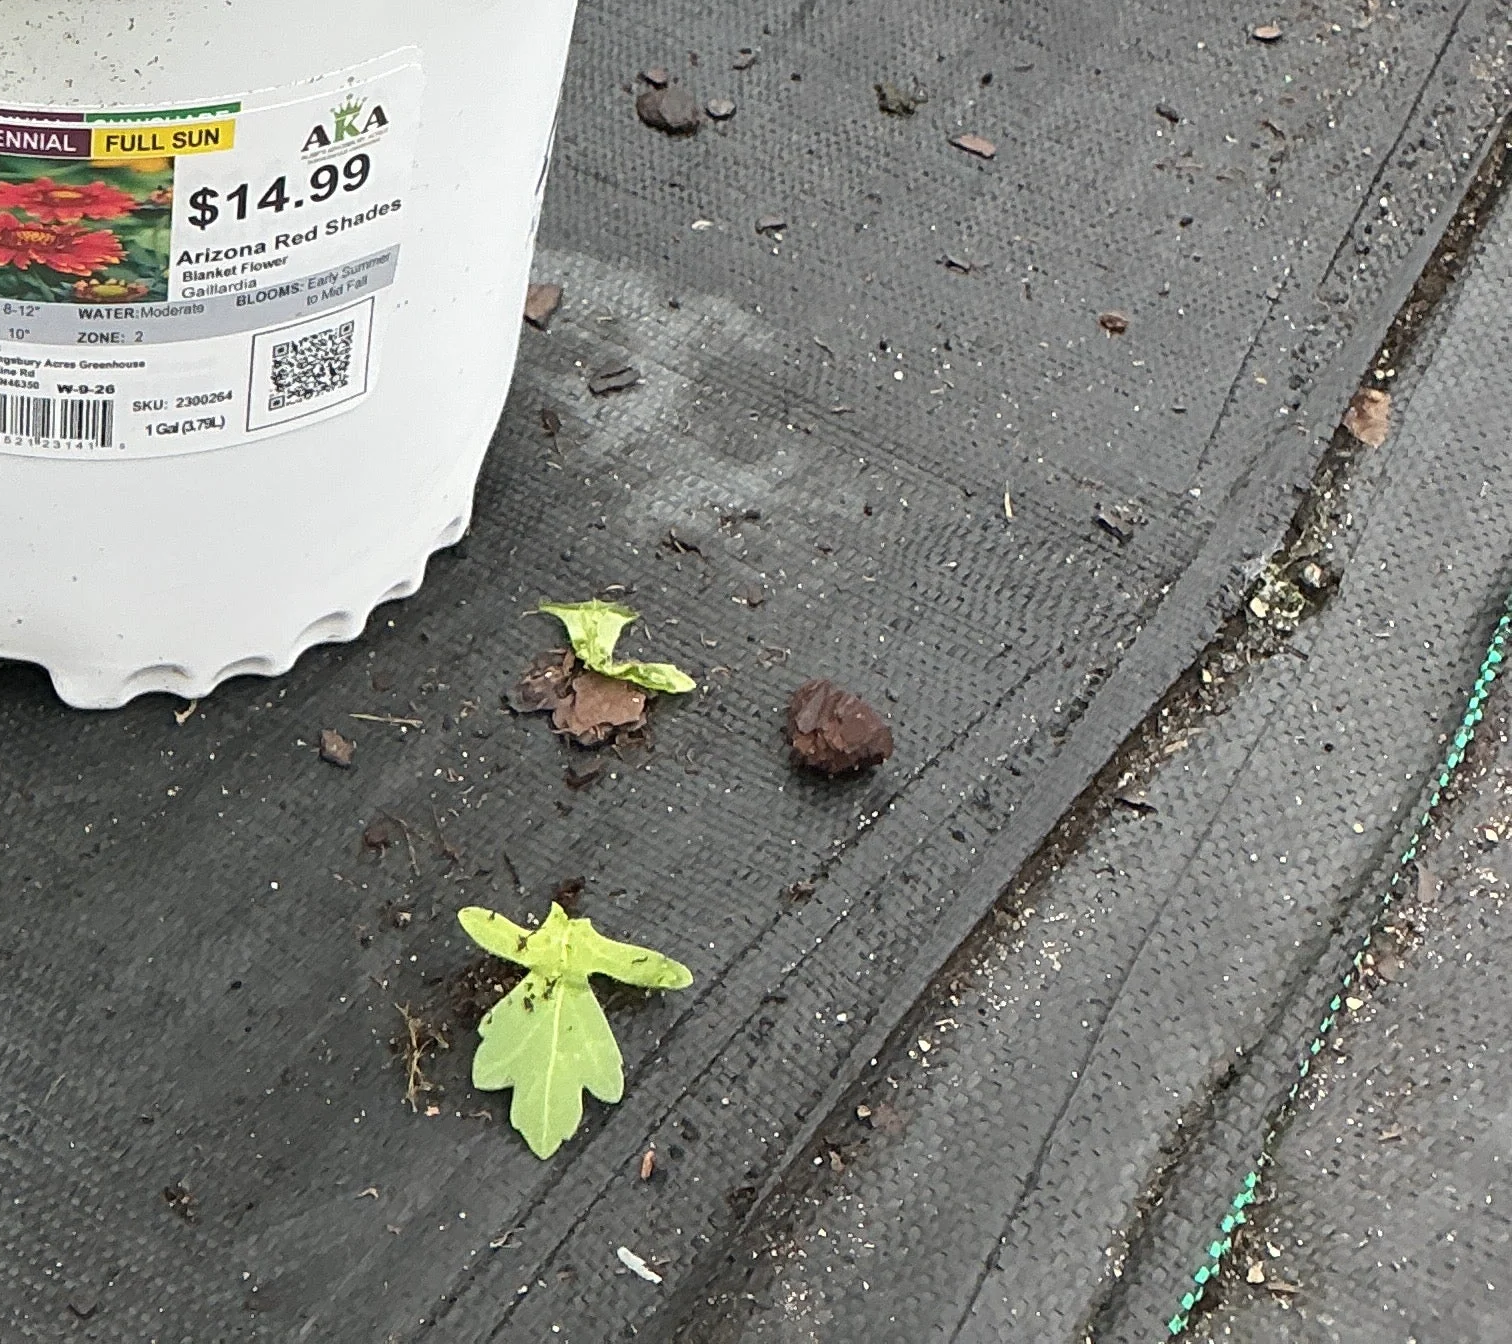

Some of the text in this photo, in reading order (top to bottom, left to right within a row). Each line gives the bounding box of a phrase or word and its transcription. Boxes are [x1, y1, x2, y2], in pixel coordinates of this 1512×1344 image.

[105, 127, 220, 154] FULL SUN
[300, 104, 389, 153] AKA
[187, 152, 371, 231] $14.99
[176, 198, 402, 266] Arizona Red Shades
[182, 255, 289, 283] Blanket Flower
[235, 251, 392, 307] BLOOMS: Early Summer
[181, 278, 258, 300] Gaillardia
[306, 275, 369, 306] to Mid Fall
[78, 302, 205, 320] WATER: Moderate
[77, 330, 144, 344] ZONE: 2
[19, 368, 36, 378] Rd
[43, 358, 76, 369] Acres
[79, 359, 146, 370] Greenhouse
[132, 390, 233, 412] SKU: 2300264
[145, 424, 153, 436] 1
[155, 421, 179, 435] Gal
